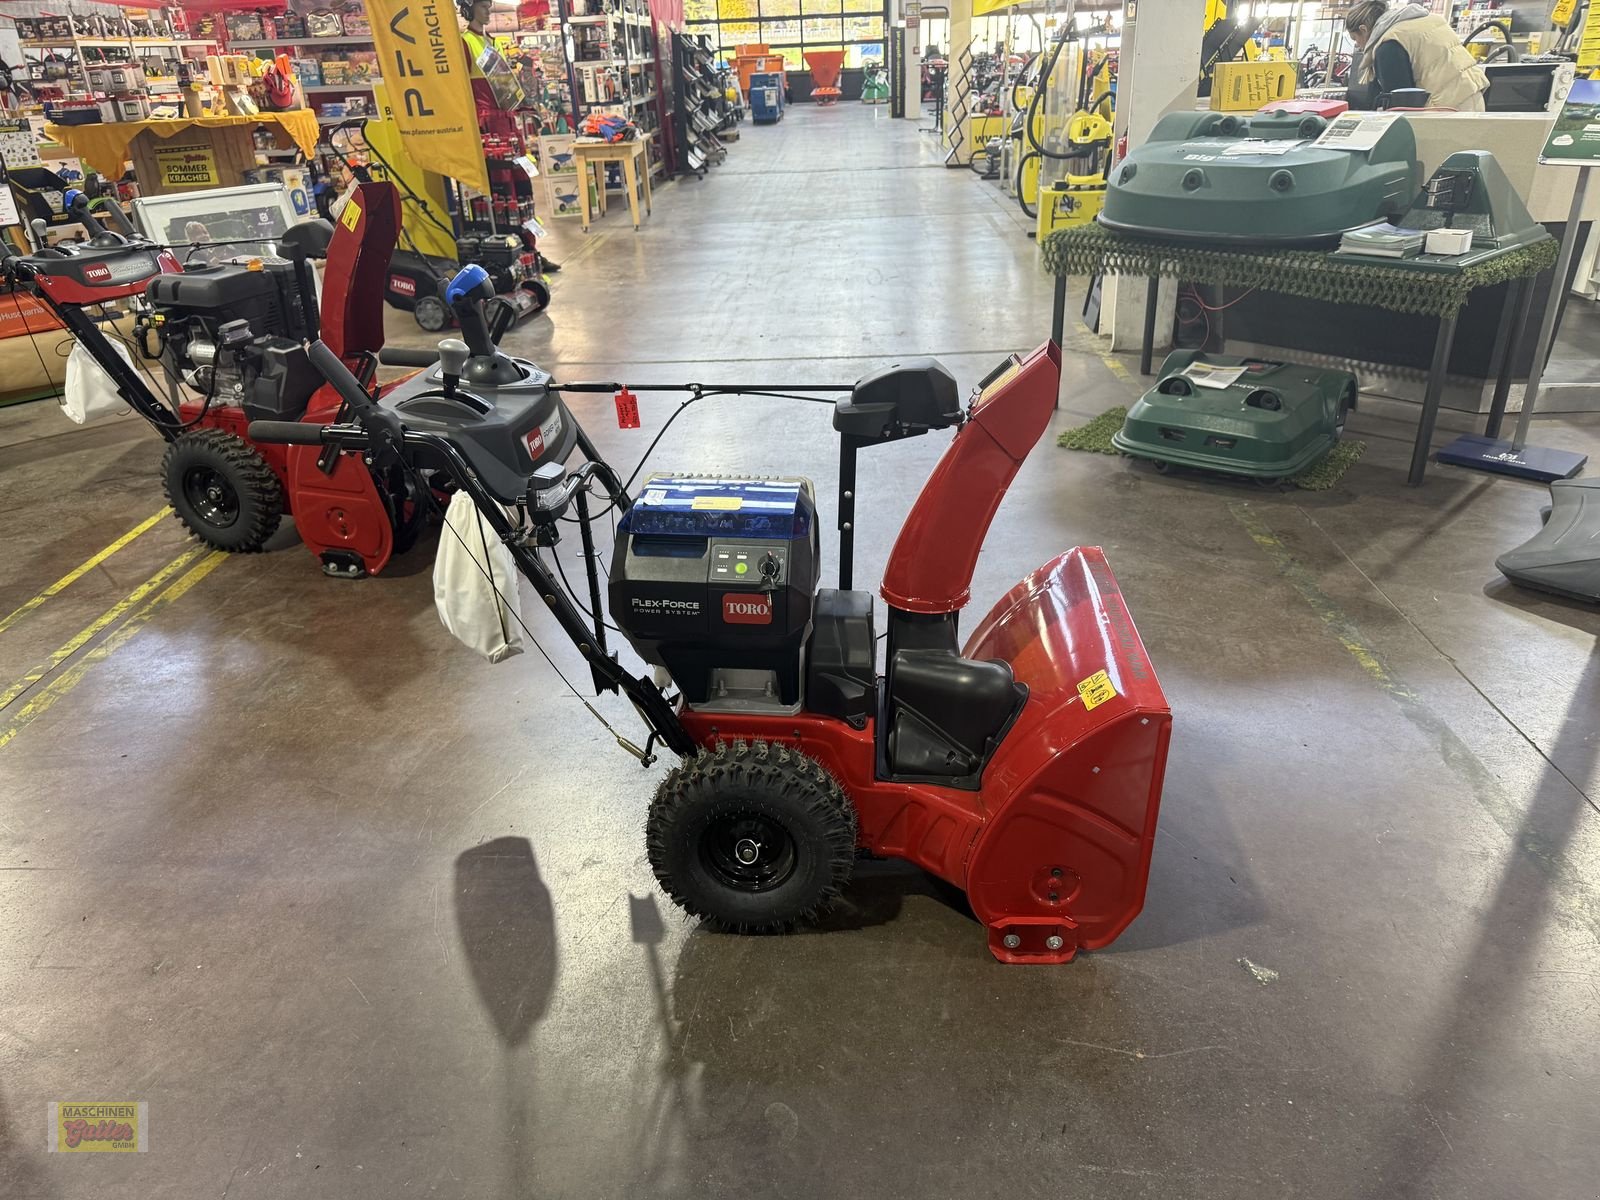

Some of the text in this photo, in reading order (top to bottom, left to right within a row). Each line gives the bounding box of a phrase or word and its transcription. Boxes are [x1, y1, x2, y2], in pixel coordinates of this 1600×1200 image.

[166, 164, 208, 173] SOMMER
[168, 173, 210, 182] KRACHER
[87, 267, 109, 278] TORO
[529, 434, 543, 453] TORO
